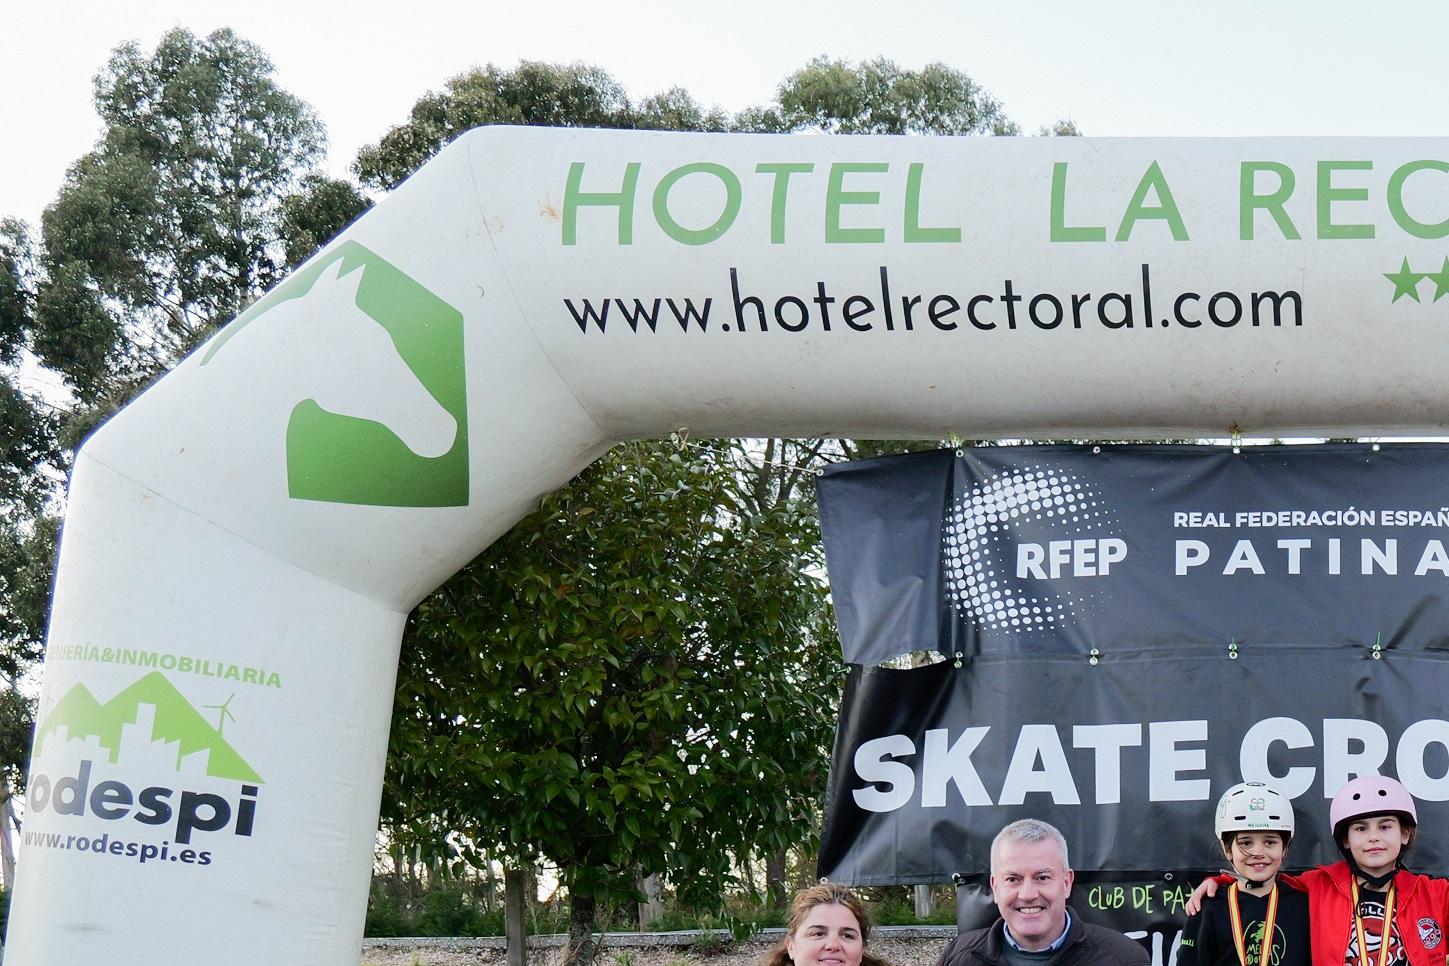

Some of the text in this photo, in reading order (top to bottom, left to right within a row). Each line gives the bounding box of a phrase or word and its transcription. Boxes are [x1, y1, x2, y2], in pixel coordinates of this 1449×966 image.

[562, 162, 962, 246] HOTEL
[1049, 160, 1189, 243] LA
[563, 264, 1304, 336] www.hotelrectoral.com
[1174, 512, 1231, 528] REAL
[1235, 507, 1376, 528] FEDERACIÓN
[1016, 538, 1128, 580] RFEP
[852, 720, 1212, 813] SKATE
[27, 759, 260, 845] odespi
[24, 831, 213, 866] www.rodespi.es
[1132, 884, 1156, 914] DE
